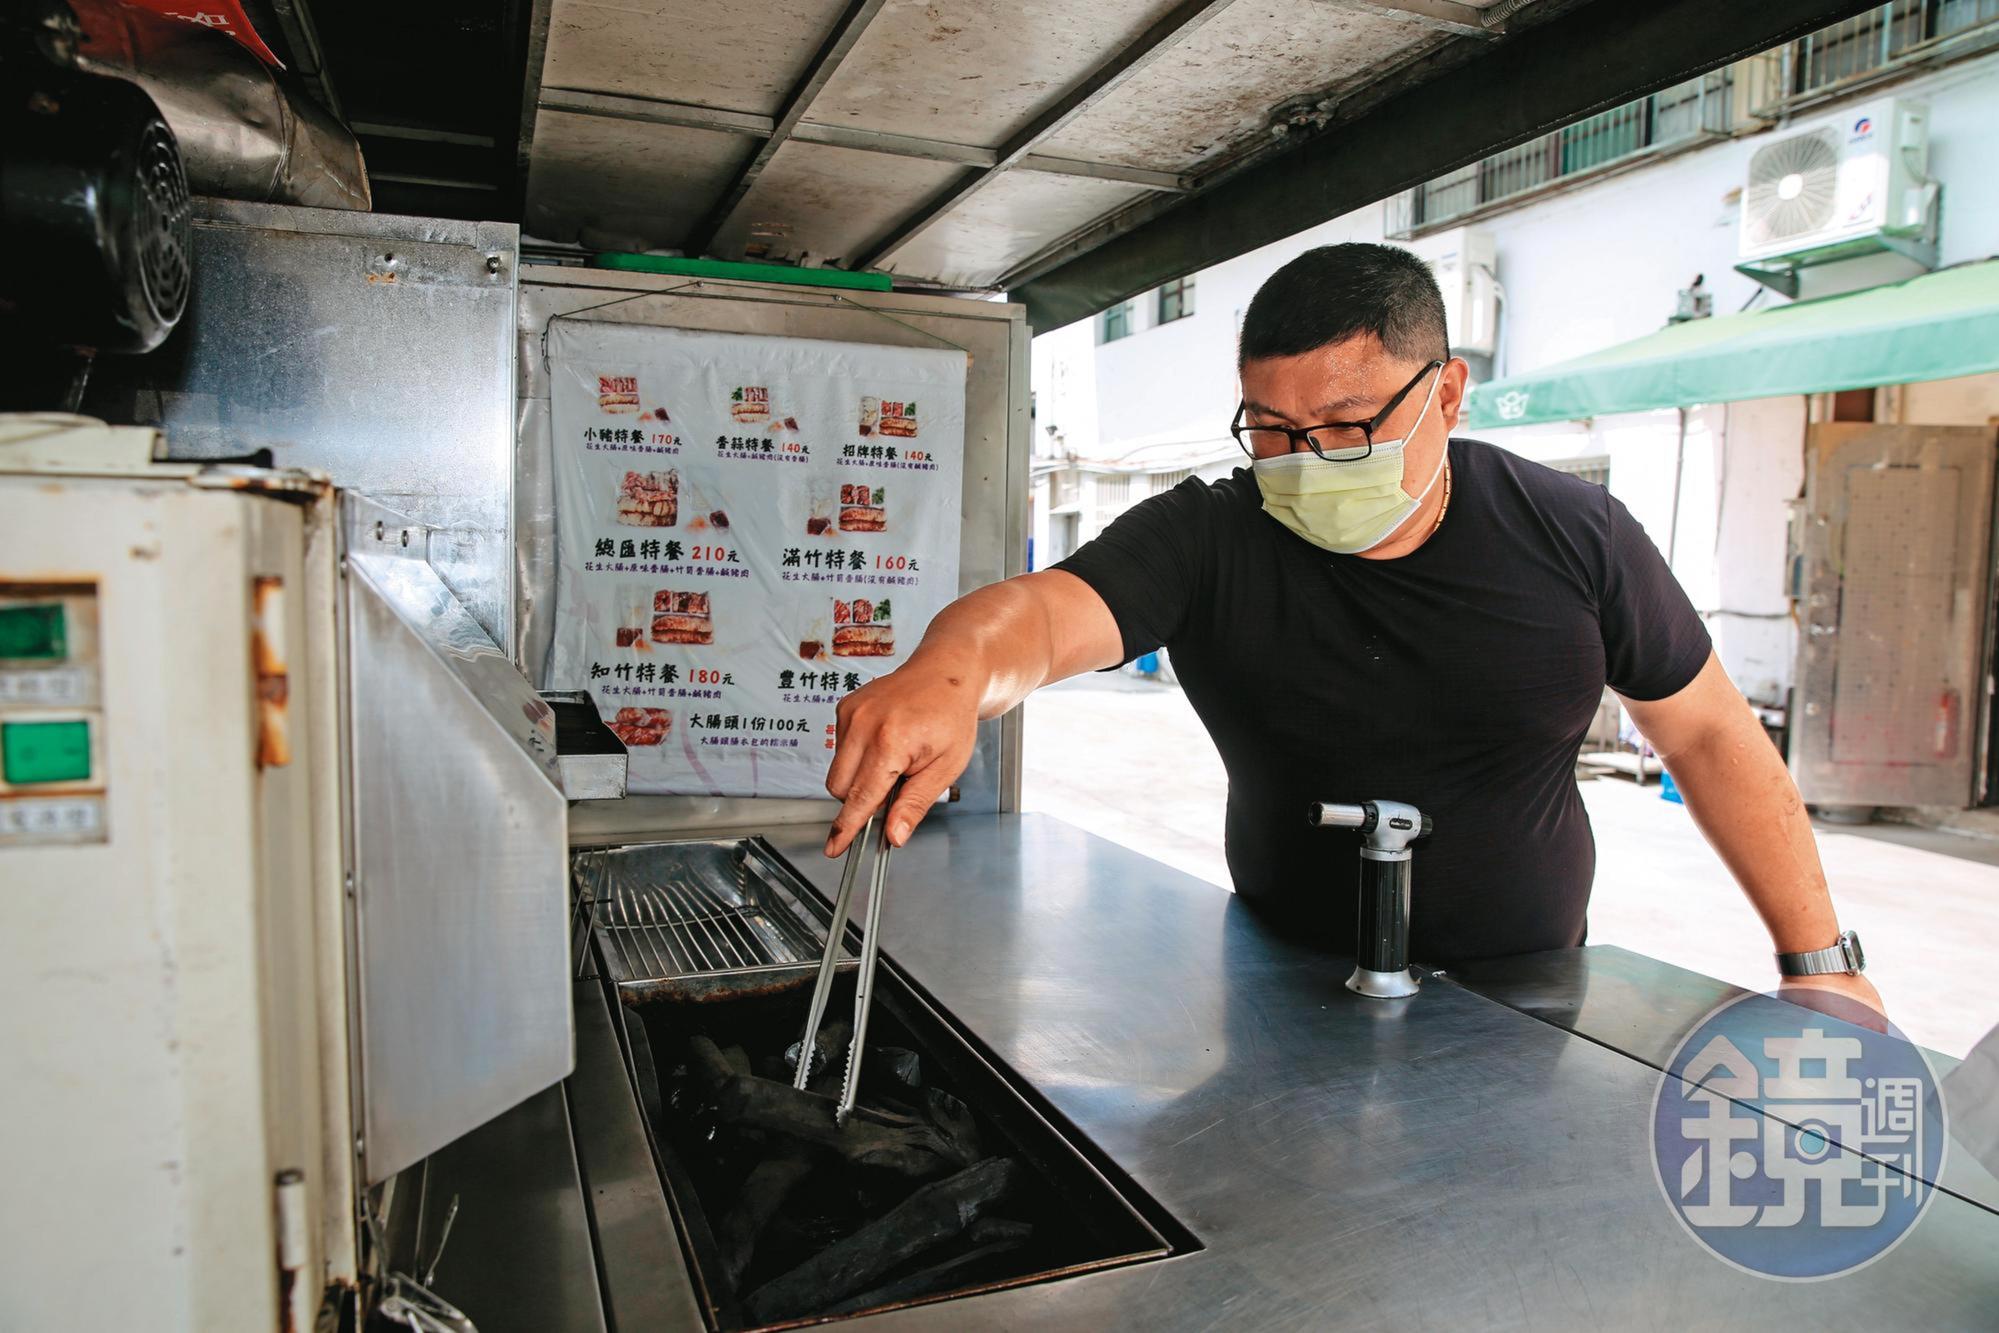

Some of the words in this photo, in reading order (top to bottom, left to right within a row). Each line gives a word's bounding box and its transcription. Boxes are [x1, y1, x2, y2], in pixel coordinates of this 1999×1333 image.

[651, 434, 682, 446] 170元
[781, 442, 810, 455] 140元
[843, 444, 898, 460] 招牌特餐
[904, 450, 933, 462] 140元
[594, 537, 684, 561] 總匯特餐
[692, 545, 740, 563] 210元
[782, 548, 867, 570] 滿竹特餐
[876, 555, 920, 571] 160元
[590, 661, 680, 684] 知竹特餐
[689, 668, 735, 686] 180元
[778, 669, 861, 692] 豐竹特餐
[690, 713, 810, 733] 大腸頭1份100元
